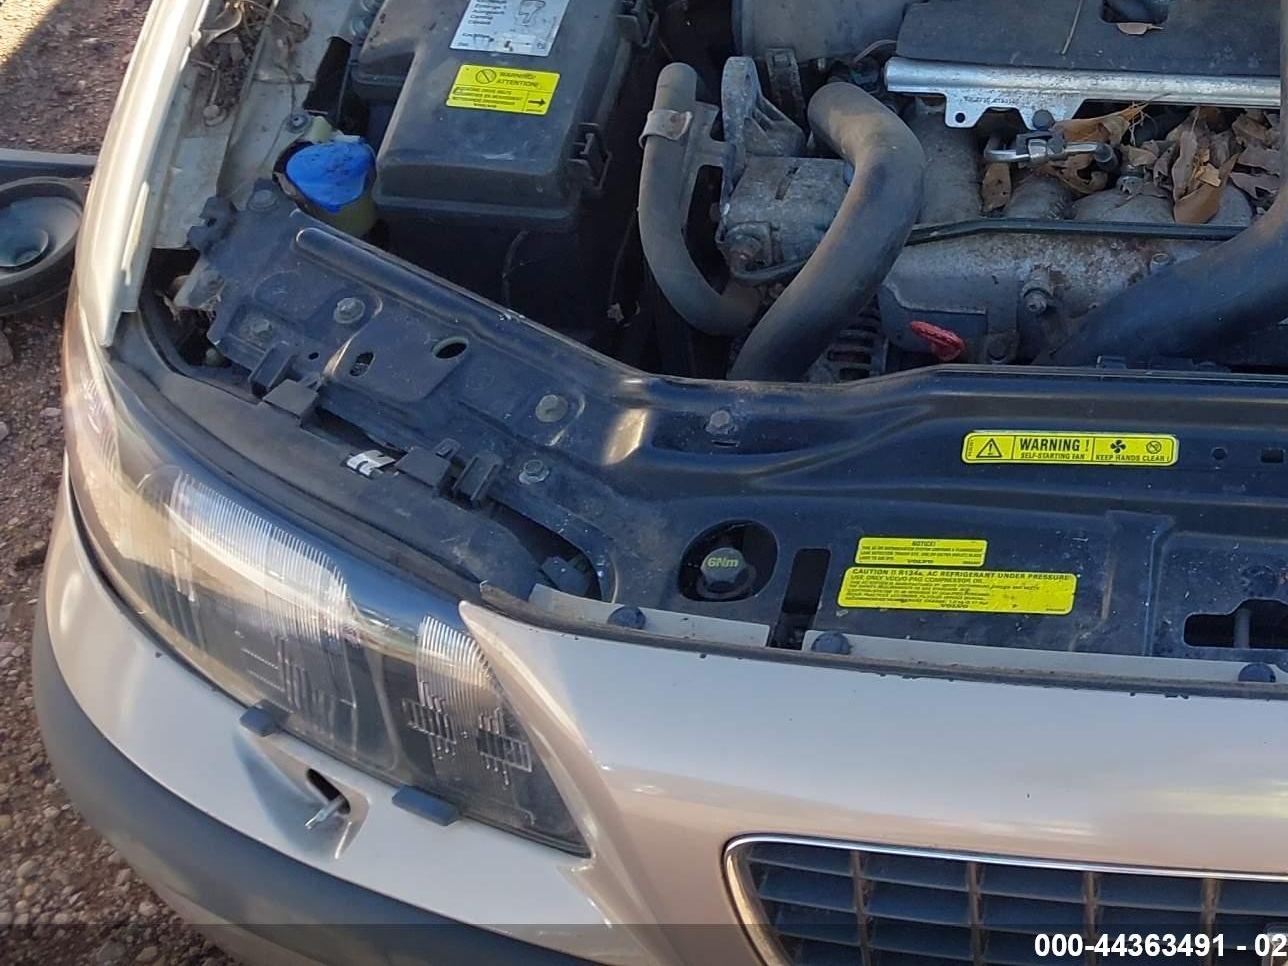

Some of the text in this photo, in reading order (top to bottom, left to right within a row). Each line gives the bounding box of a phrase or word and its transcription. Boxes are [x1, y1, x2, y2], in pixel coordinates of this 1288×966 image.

[1019, 438, 1080, 452] WARNING
[1020, 451, 1070, 460] SELF-STARTING
[1115, 454, 1141, 462] HANDS
[1142, 454, 1165, 462] CLEAR
[707, 557, 739, 568] 6Nm
[852, 568, 889, 576] CAUTION
[939, 571, 996, 579] REFRIGERANT
[997, 572, 1025, 580] UNDER
[1027, 573, 1069, 581] PRESSURE
